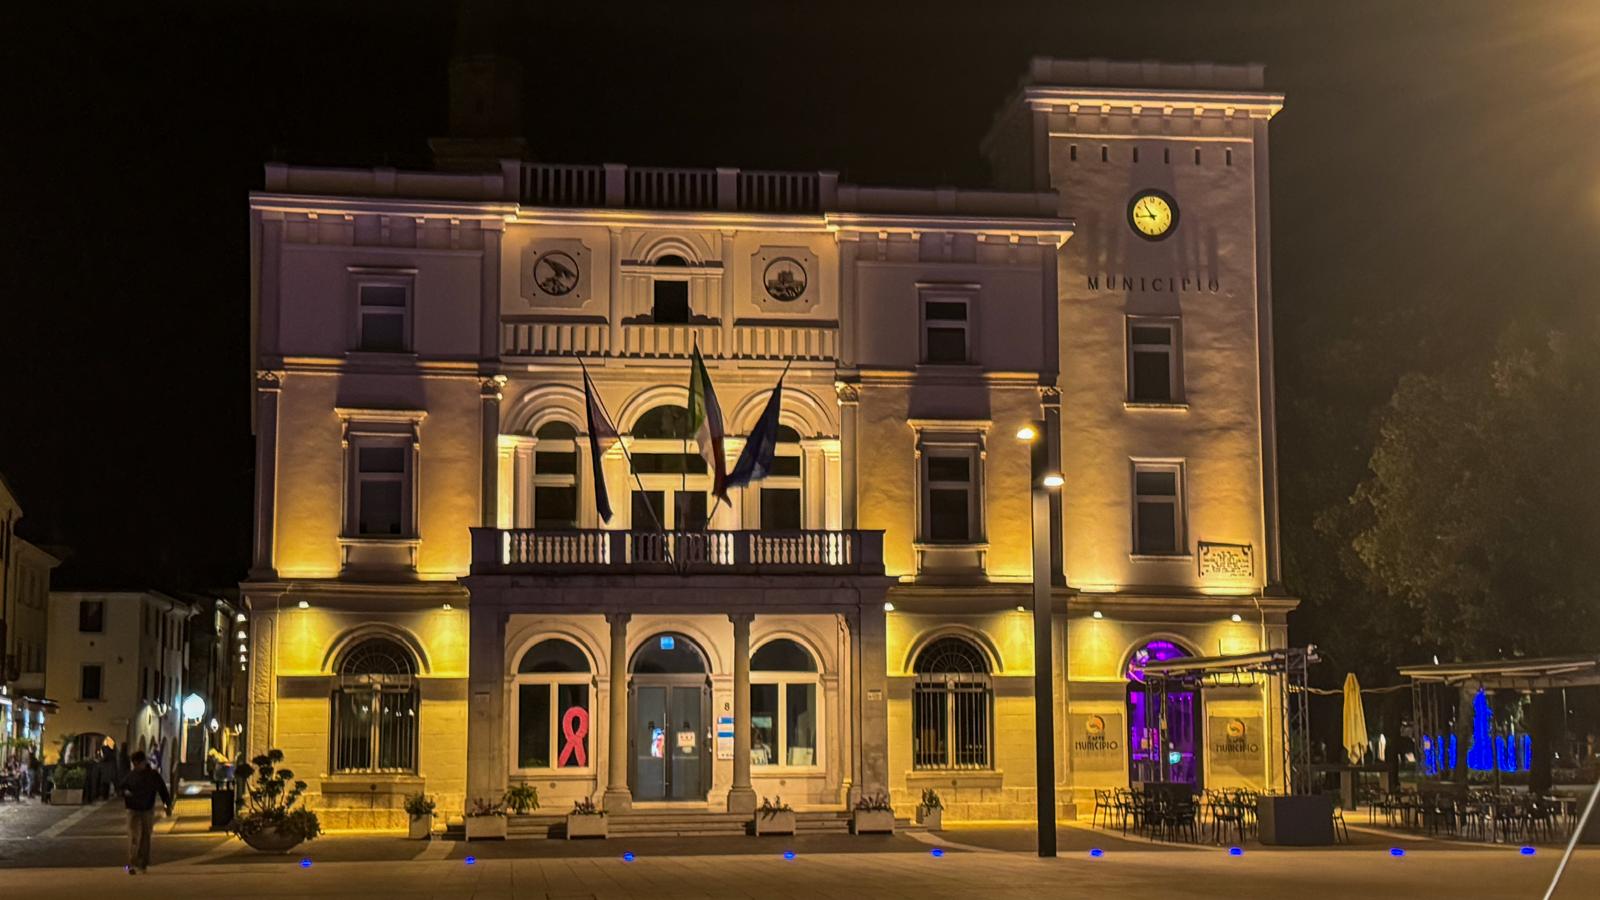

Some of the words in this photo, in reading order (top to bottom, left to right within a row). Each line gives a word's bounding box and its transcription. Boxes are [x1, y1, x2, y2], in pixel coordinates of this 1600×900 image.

[1087, 276, 1219, 292] MUNICIPIO
[724, 702, 730, 711] 8
[1074, 740, 1118, 751] MUNICIPIO
